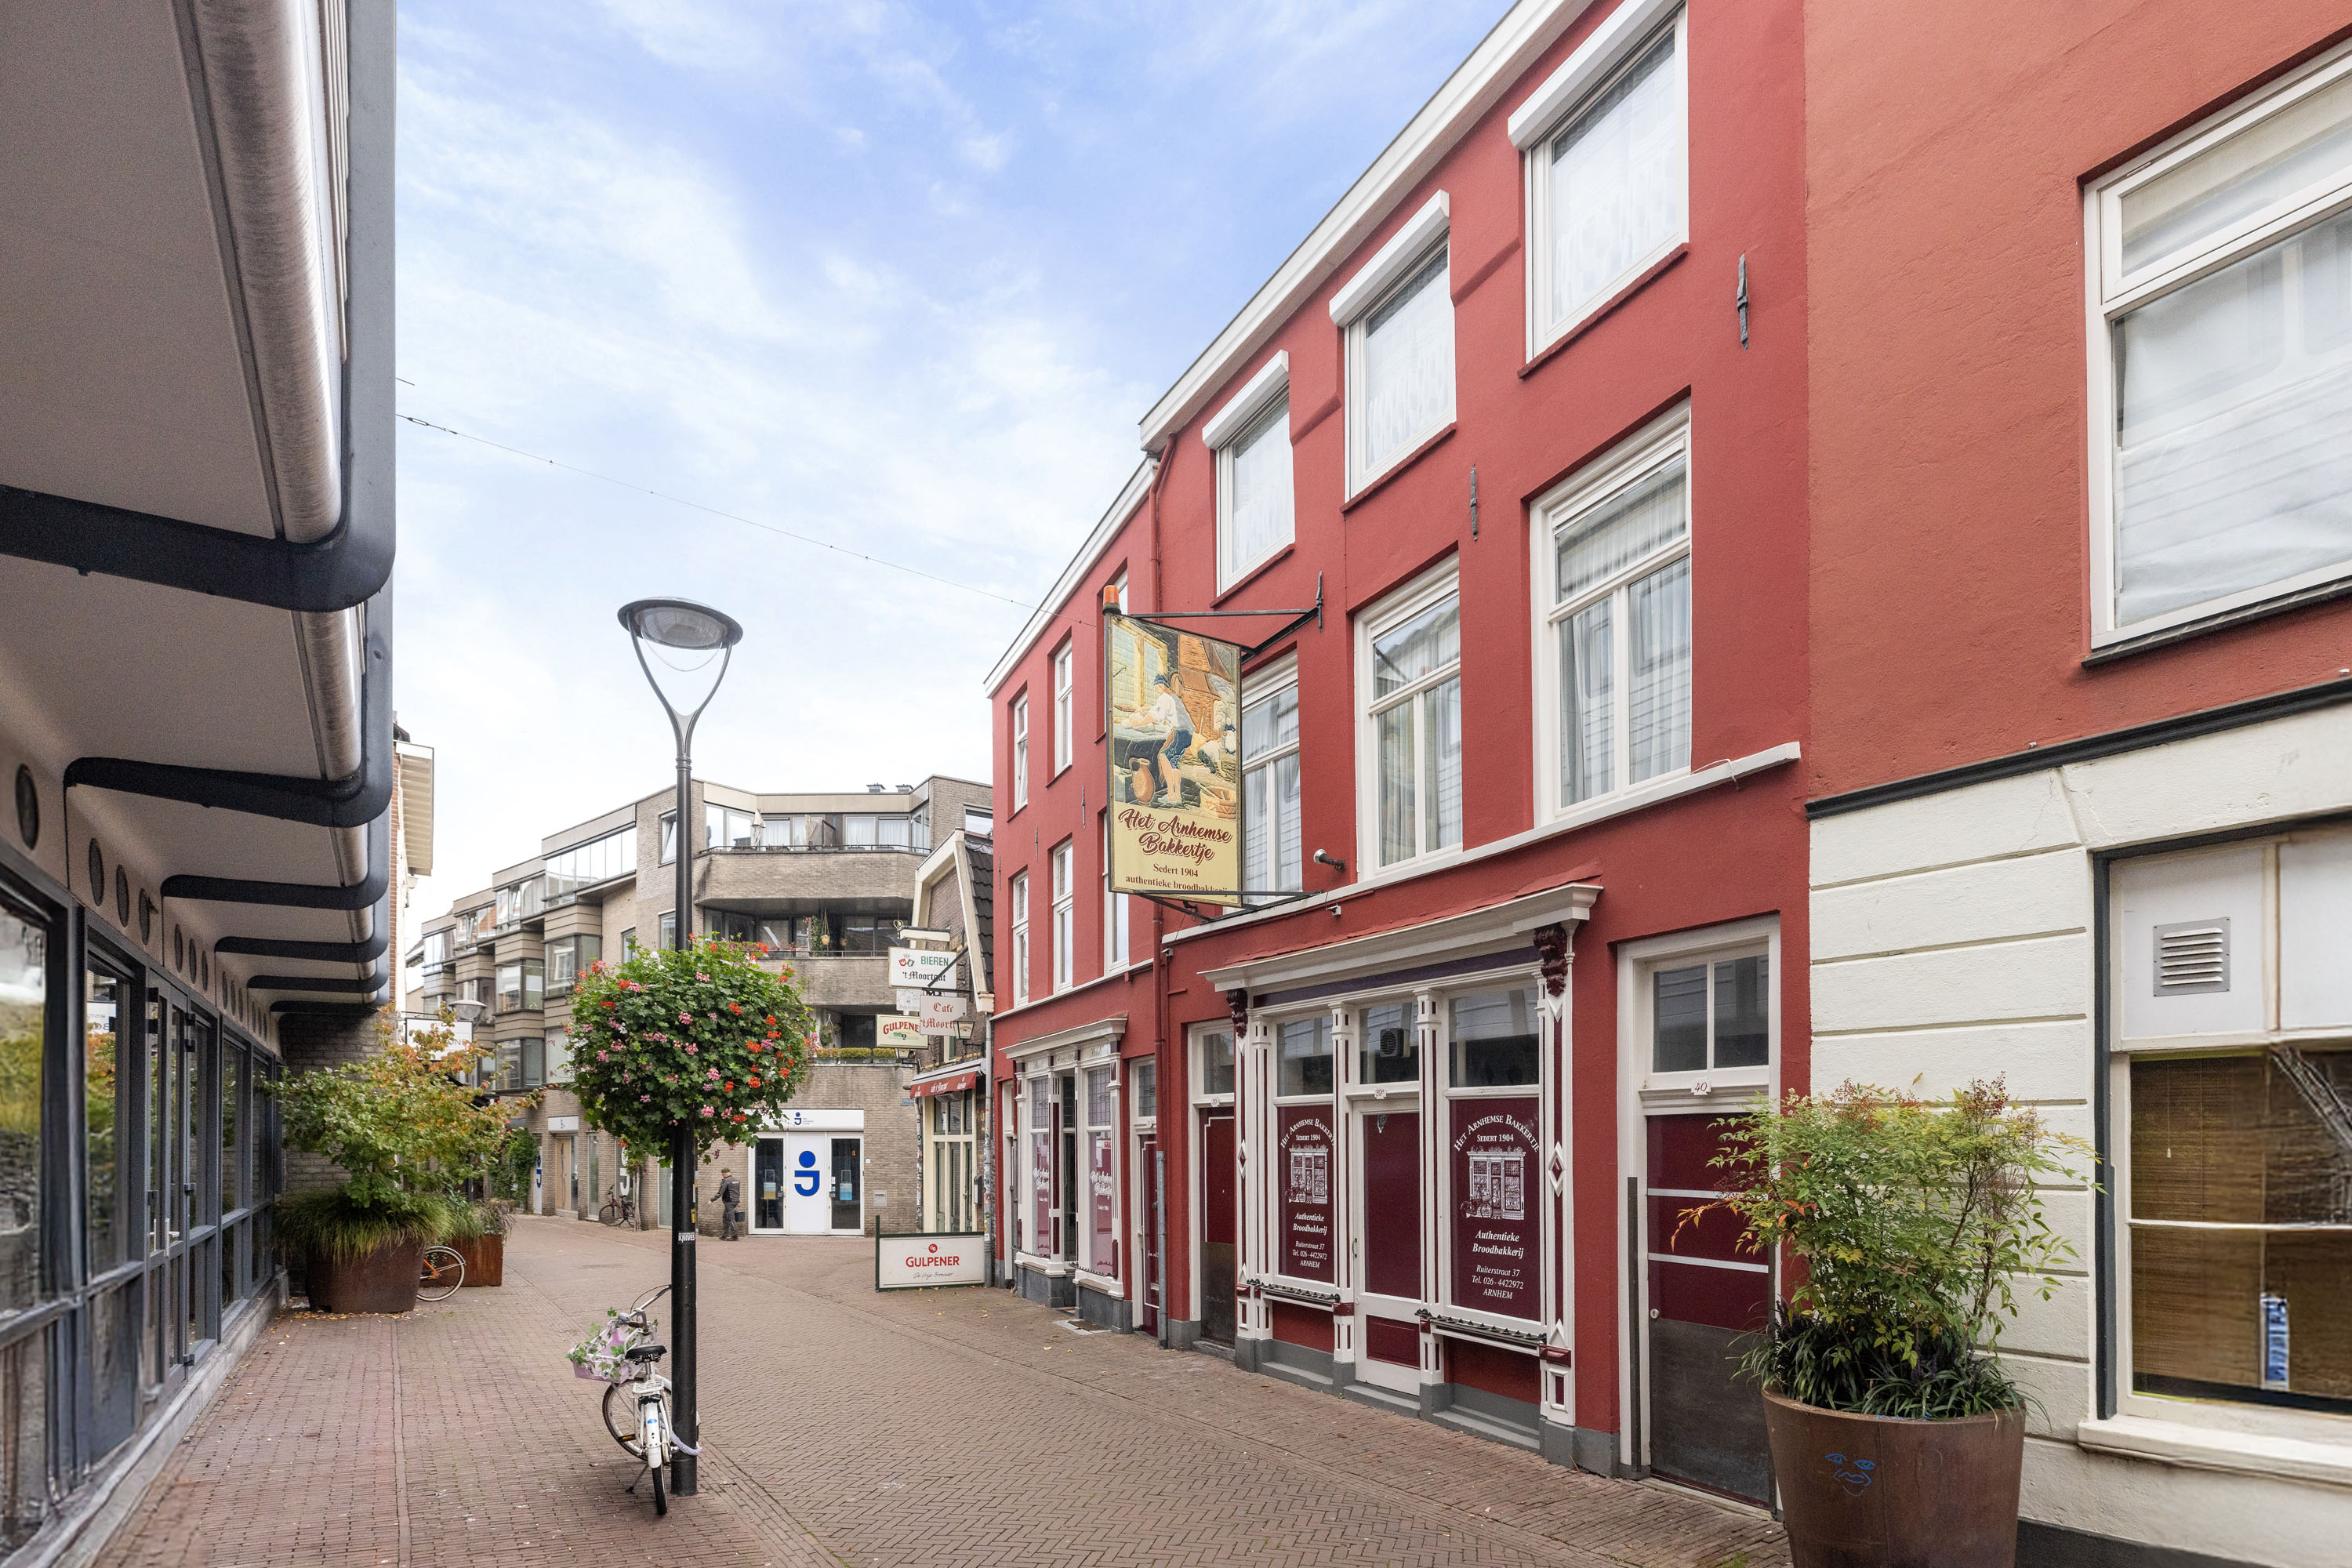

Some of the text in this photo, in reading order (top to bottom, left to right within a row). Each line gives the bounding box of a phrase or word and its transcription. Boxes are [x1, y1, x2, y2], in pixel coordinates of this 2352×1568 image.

[1117, 808, 1232, 844] Het Arnhemse
[1138, 831, 1215, 866] Bakkertje
[1153, 863, 1199, 877] Sedert 1904
[1125, 875, 1228, 897] authentieke broodbakk
[920, 956, 949, 967] BIEREN
[883, 1021, 919, 1035] GULPENE
[925, 1018, 953, 1029] Moort
[1694, 1082, 1708, 1092] 40
[1280, 1132, 1290, 1149] HET
[1290, 1119, 1314, 1135] ARNHEMSE
[1454, 1114, 1540, 1152] HET ARNHEMSE BAKKERTJE
[1294, 1212, 1325, 1222] Authentieke
[1293, 1223, 1327, 1236] Broodbakkerij
[1475, 1229, 1519, 1242] Authentieke
[1472, 1243, 1524, 1259] Broodbakkerij
[906, 1256, 960, 1268] GULPENER
[1300, 1260, 1320, 1269] ARNHEM
[1476, 1265, 1520, 1277] Ruiterstraat 37
[1472, 1275, 1482, 1283] Tel.
[1483, 1288, 1513, 1299] ARNHEM
